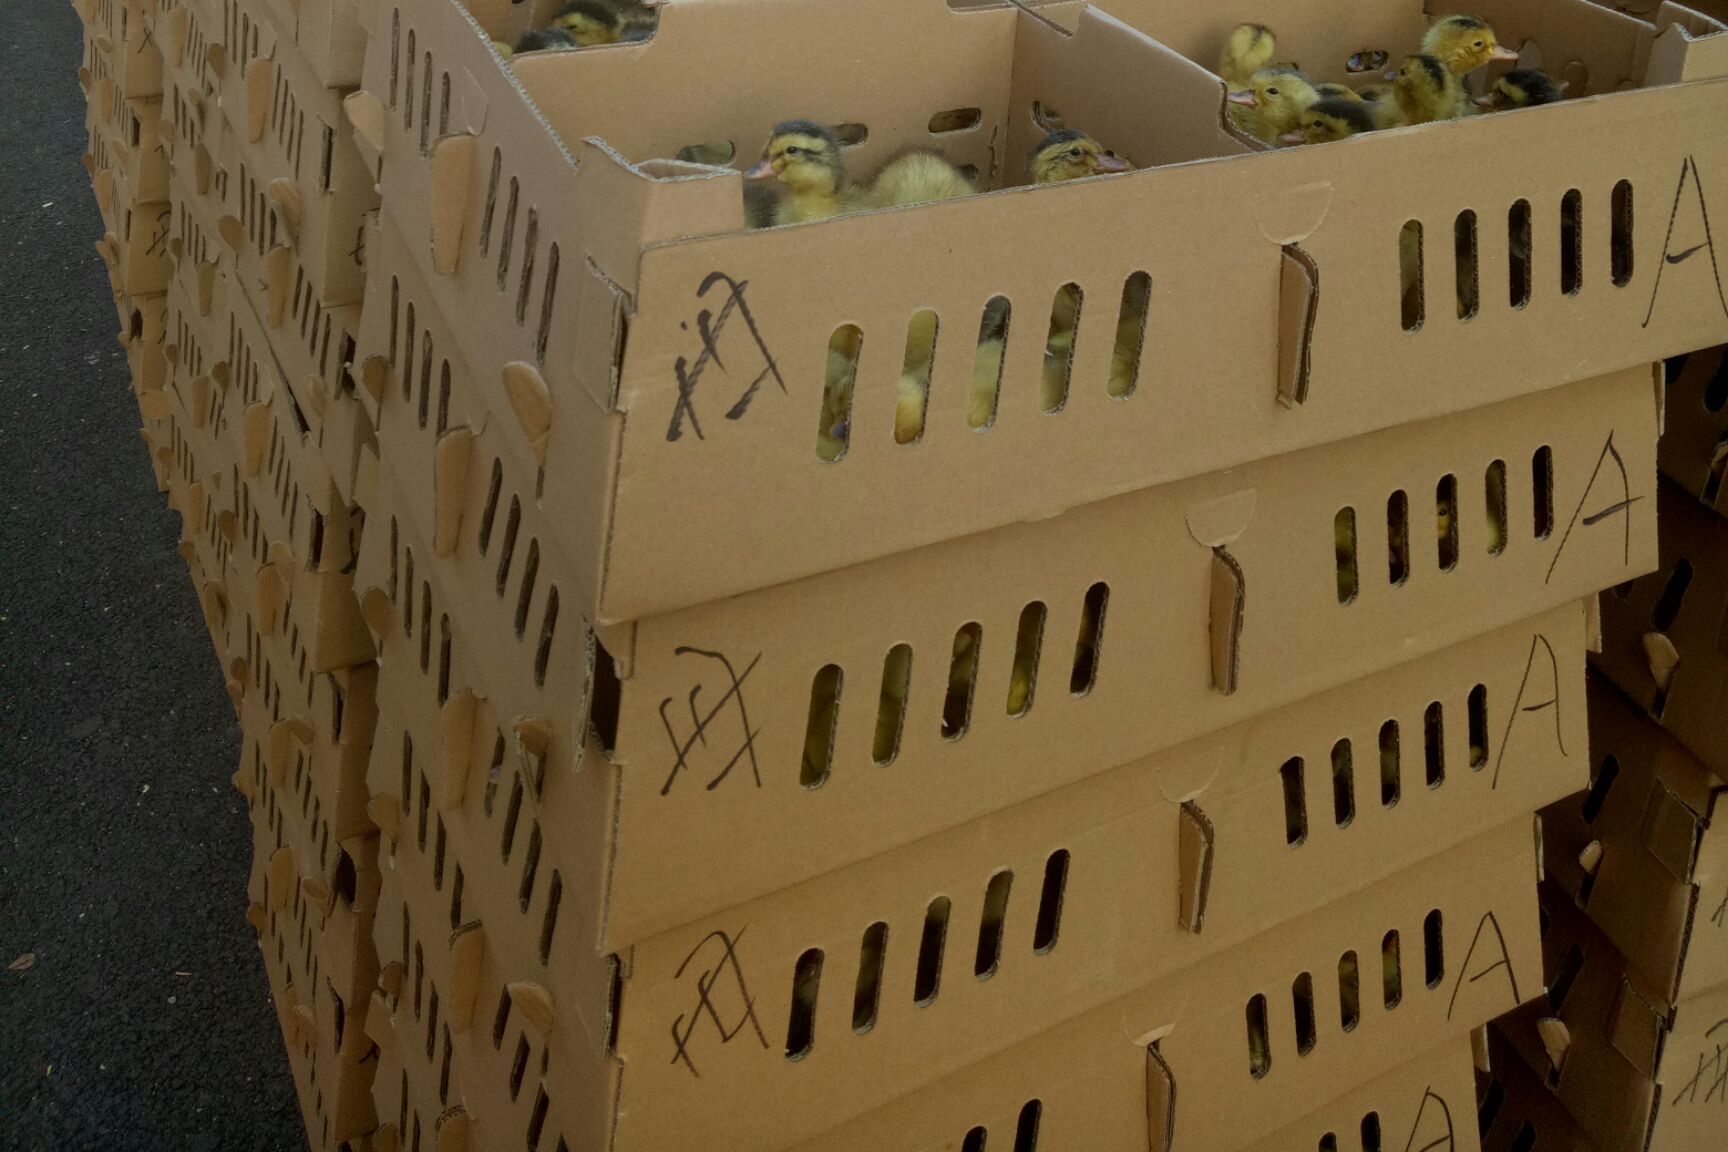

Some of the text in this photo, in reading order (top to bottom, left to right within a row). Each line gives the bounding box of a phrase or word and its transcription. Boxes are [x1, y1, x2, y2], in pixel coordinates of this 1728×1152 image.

[1641, 154, 1728, 329] A
[1545, 429, 1645, 585] A
[1492, 633, 1568, 790] A
[1446, 910, 1521, 1022] A
